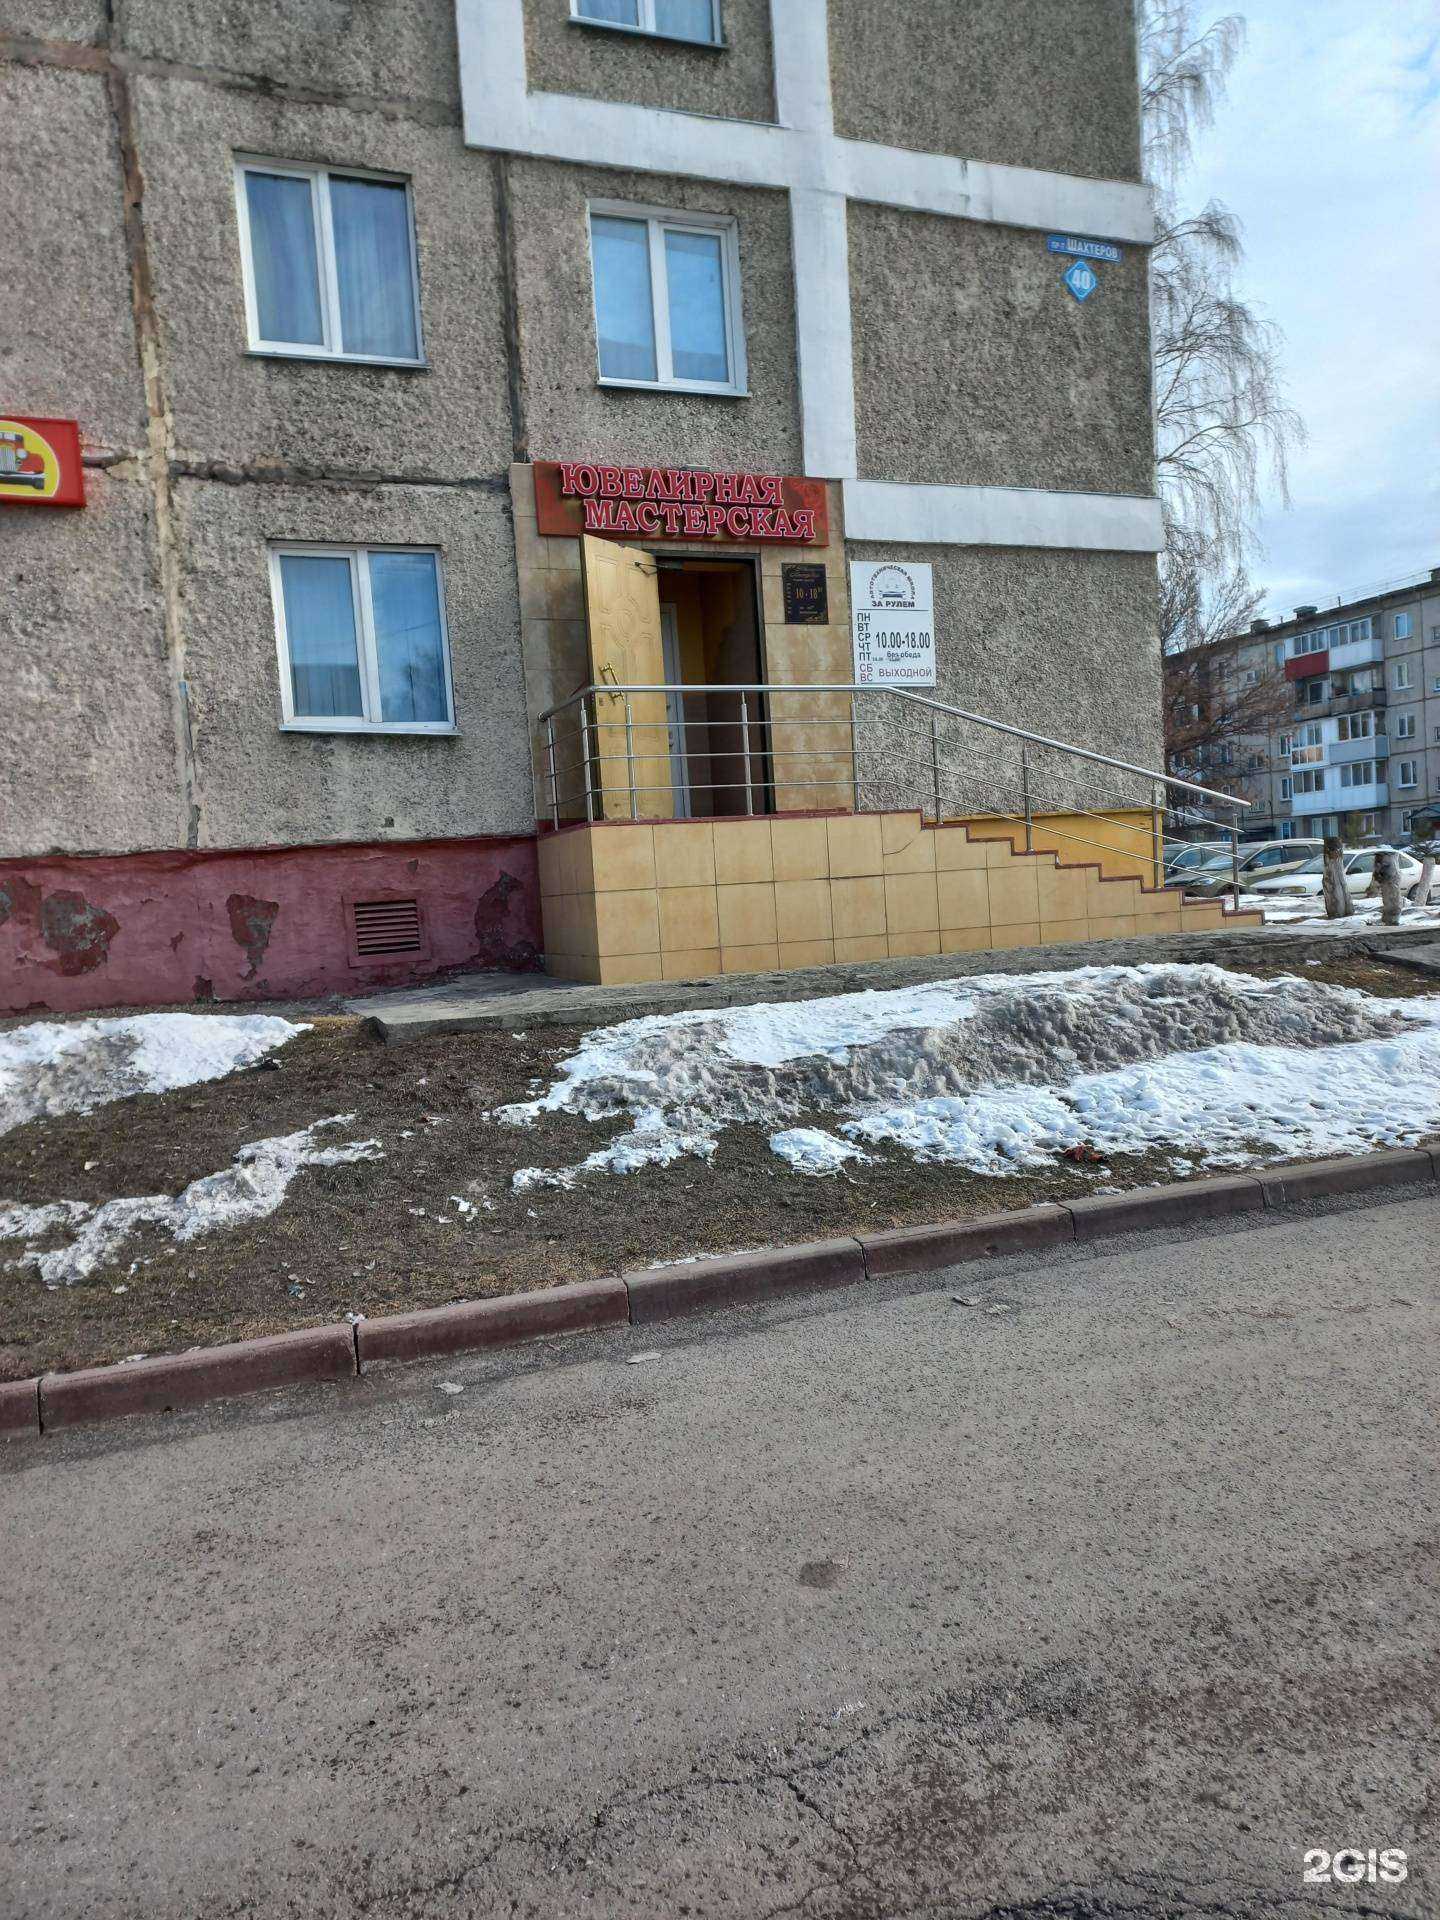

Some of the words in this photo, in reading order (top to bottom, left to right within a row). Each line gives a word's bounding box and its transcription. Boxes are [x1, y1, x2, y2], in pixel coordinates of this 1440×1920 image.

[1067, 238, 1118, 258] ШАХТЕРОВ
[1072, 269, 1090, 289] 40
[560, 463, 784, 507] ЮВЕЛИРНАЯ
[583, 498, 816, 538] МАСТЕРСКАЯ
[871, 600, 883, 608] ЗА
[885, 600, 915, 608] РУЛЕМ
[857, 613, 871, 622] ПН
[857, 623, 869, 631] ВТ
[857, 633, 871, 642] СР
[875, 631, 931, 649] 10.00-18.00
[858, 643, 871, 651] ЧТ
[859, 652, 871, 661] ПТ
[900, 651, 921, 659] обеда
[859, 663, 873, 673] СБ
[878, 667, 932, 678] ВЫХОДНОЙ
[860, 673, 873, 682] ВС
